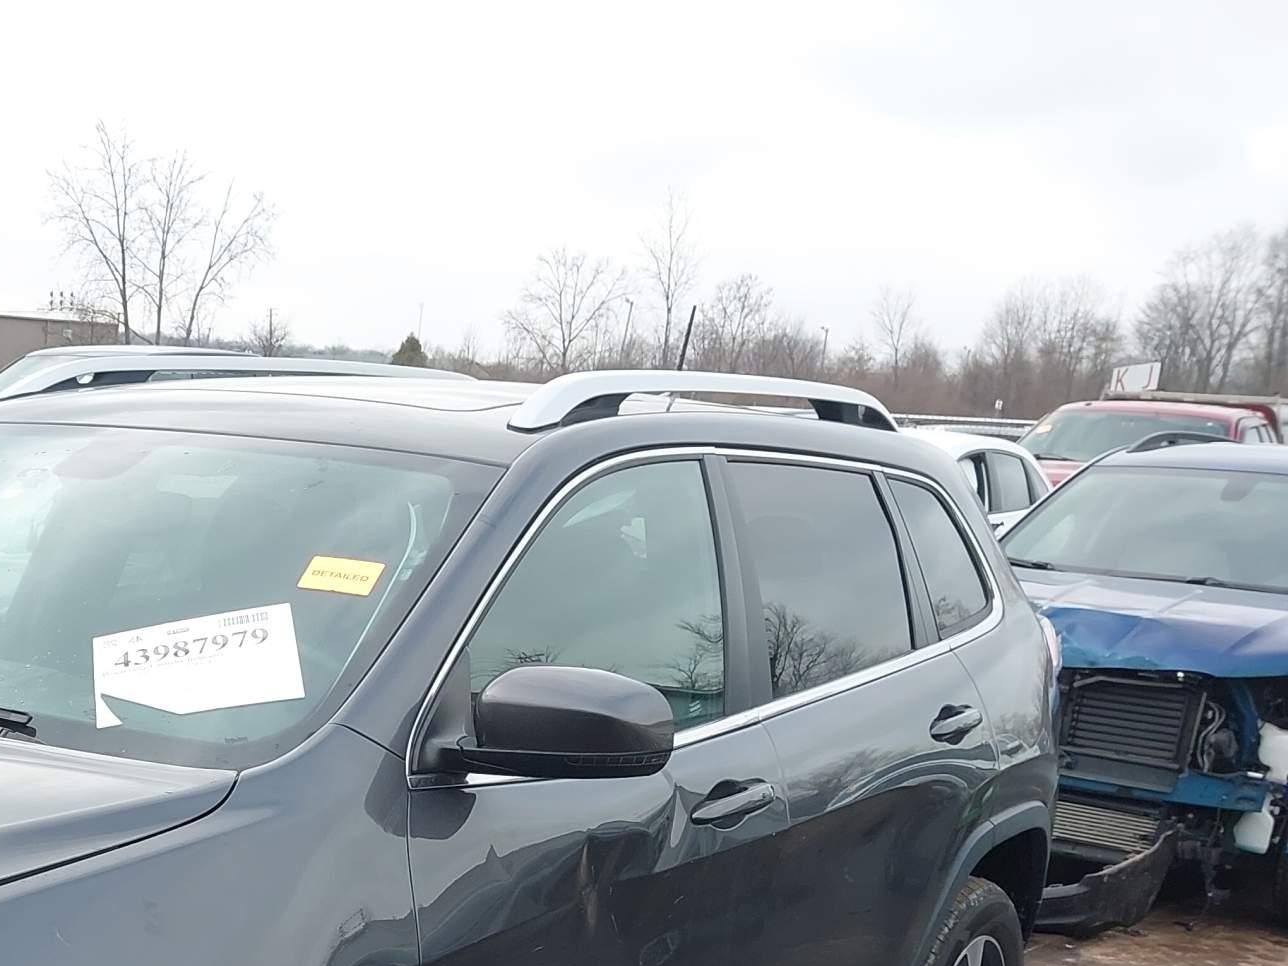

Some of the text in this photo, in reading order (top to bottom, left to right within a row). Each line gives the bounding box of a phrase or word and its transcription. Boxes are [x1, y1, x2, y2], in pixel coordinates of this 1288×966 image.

[1114, 365, 1154, 392] K J
[311, 569, 370, 582] DETAILED
[113, 627, 269, 668] 43987979
